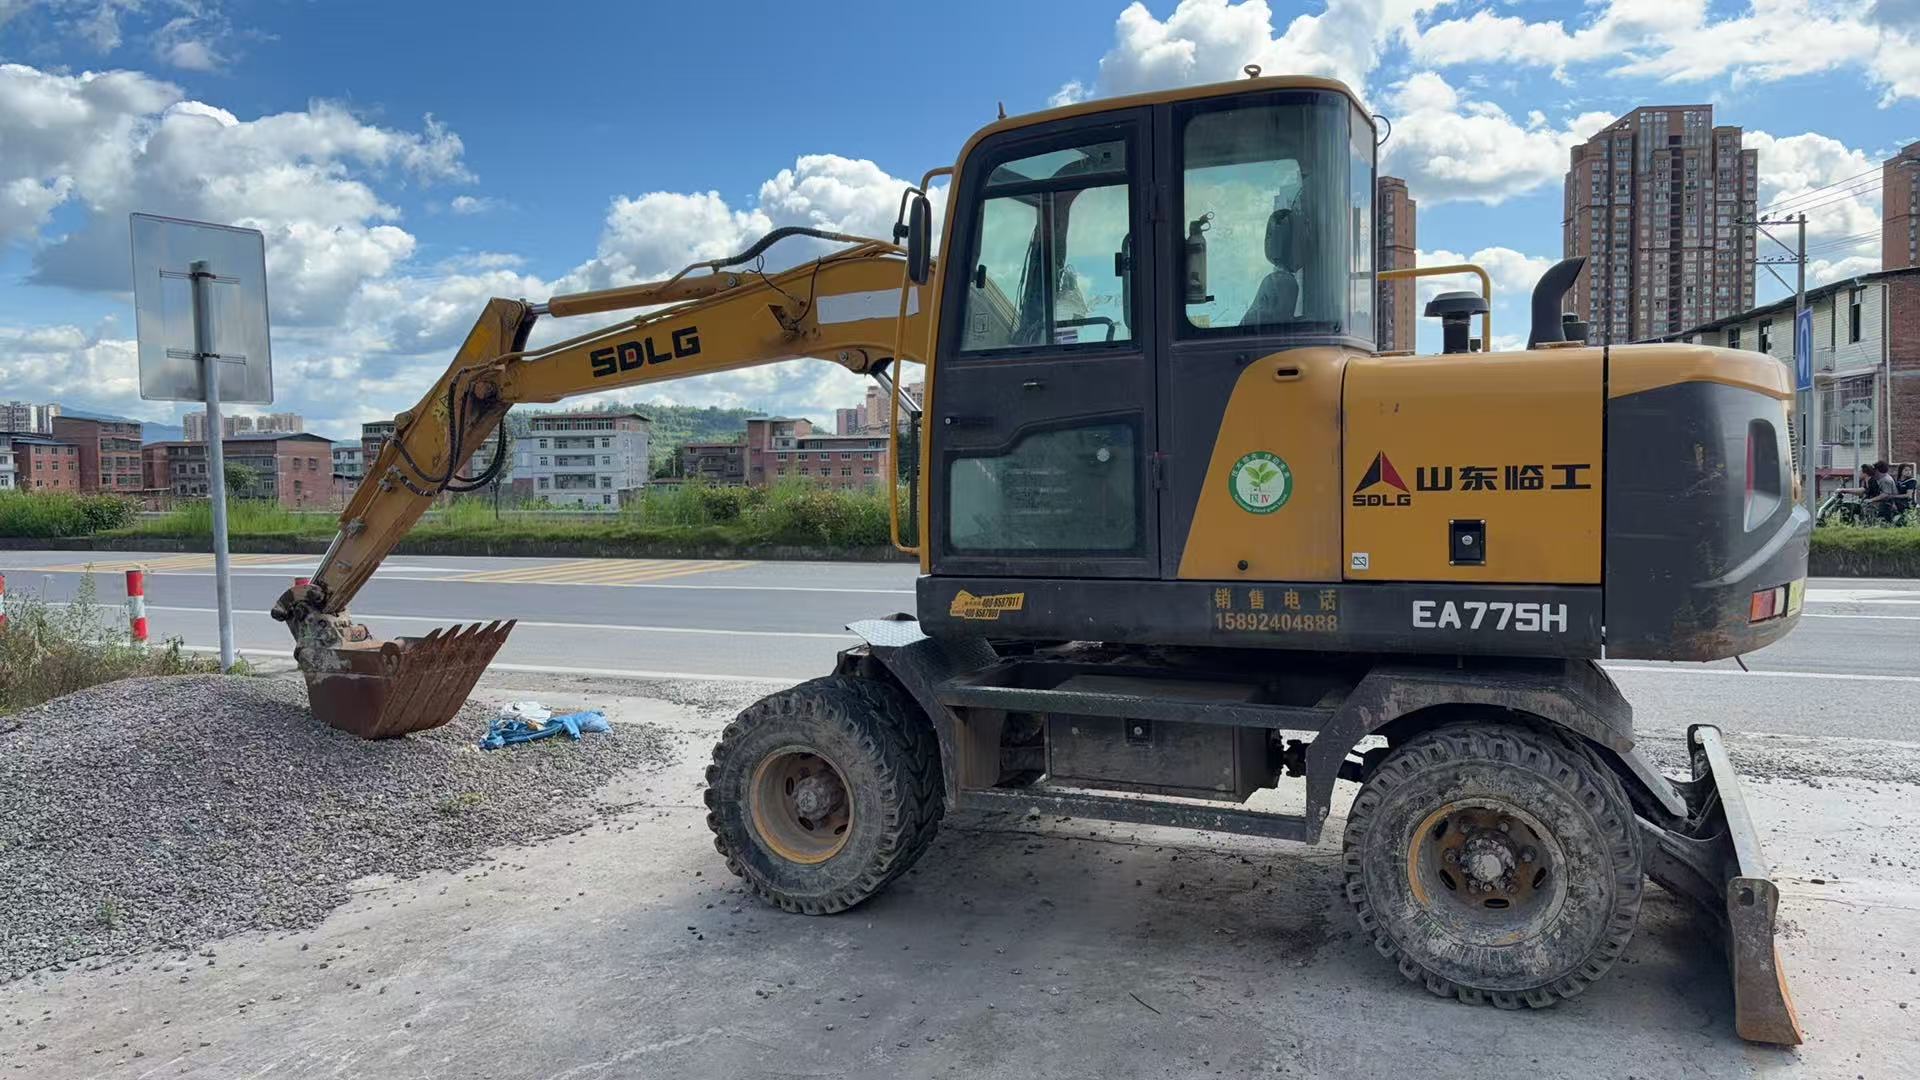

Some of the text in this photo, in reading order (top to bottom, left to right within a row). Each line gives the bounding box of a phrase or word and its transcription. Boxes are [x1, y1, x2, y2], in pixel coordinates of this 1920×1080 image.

[590, 326, 701, 378] SDLG
[1416, 464, 1591, 491] 山东临工
[1353, 494, 1411, 507] SDLG
[1216, 613, 1337, 631] 15892404888
[1412, 600, 1567, 633] EA775H
